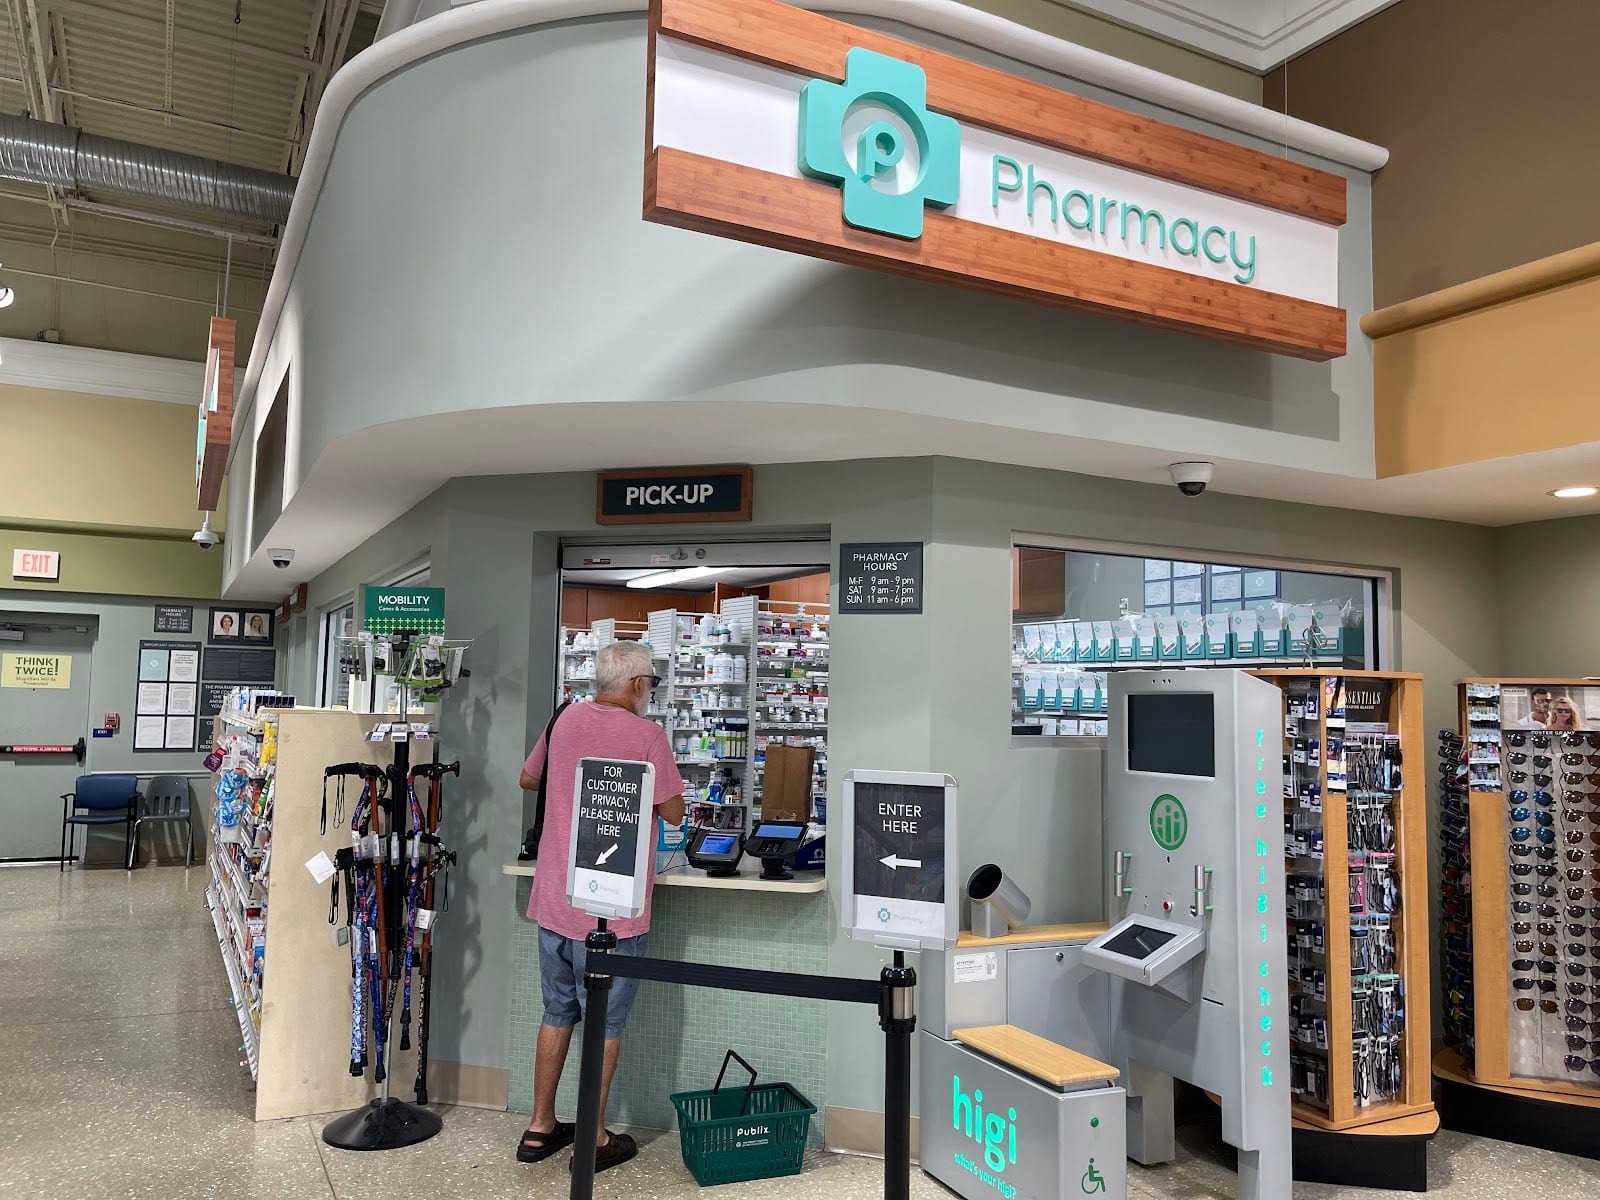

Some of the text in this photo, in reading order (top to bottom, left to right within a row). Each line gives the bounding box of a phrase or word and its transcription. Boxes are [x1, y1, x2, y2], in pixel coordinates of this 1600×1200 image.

[991, 152, 1257, 284] Pharmacy
[625, 484, 714, 506] PICK-UP
[22, 553, 51, 573] EXIT
[853, 553, 908, 561] PHARMACY
[864, 562, 898, 570] HOURS
[848, 576, 864, 584] M-F
[870, 576, 876, 584] 9
[895, 576, 900, 584] 9
[902, 578, 914, 587] pm
[848, 586, 864, 594] SAT
[870, 586, 876, 594] 9
[895, 586, 900, 594] 7
[902, 587, 914, 596] pm
[378, 595, 430, 605] MOBILITY
[846, 595, 863, 604] SUN
[867, 595, 875, 603] 11
[894, 595, 900, 603] 6
[901, 596, 914, 606] pm
[16, 656, 54, 666] THINK
[604, 766, 622, 778] FOR
[587, 779, 637, 794] CUSTOMER
[592, 794, 630, 810] PRIVACY,
[580, 808, 640, 824] PLEASE WAIT
[878, 803, 922, 817] ENTER
[597, 824, 620, 837] HERE
[883, 820, 917, 834] HERE
[1256, 728, 1273, 1086] free higi check
[953, 1075, 1017, 1172] higi
[737, 1126, 769, 1137] Publix
[954, 1152, 1016, 1199] what's your higi?
